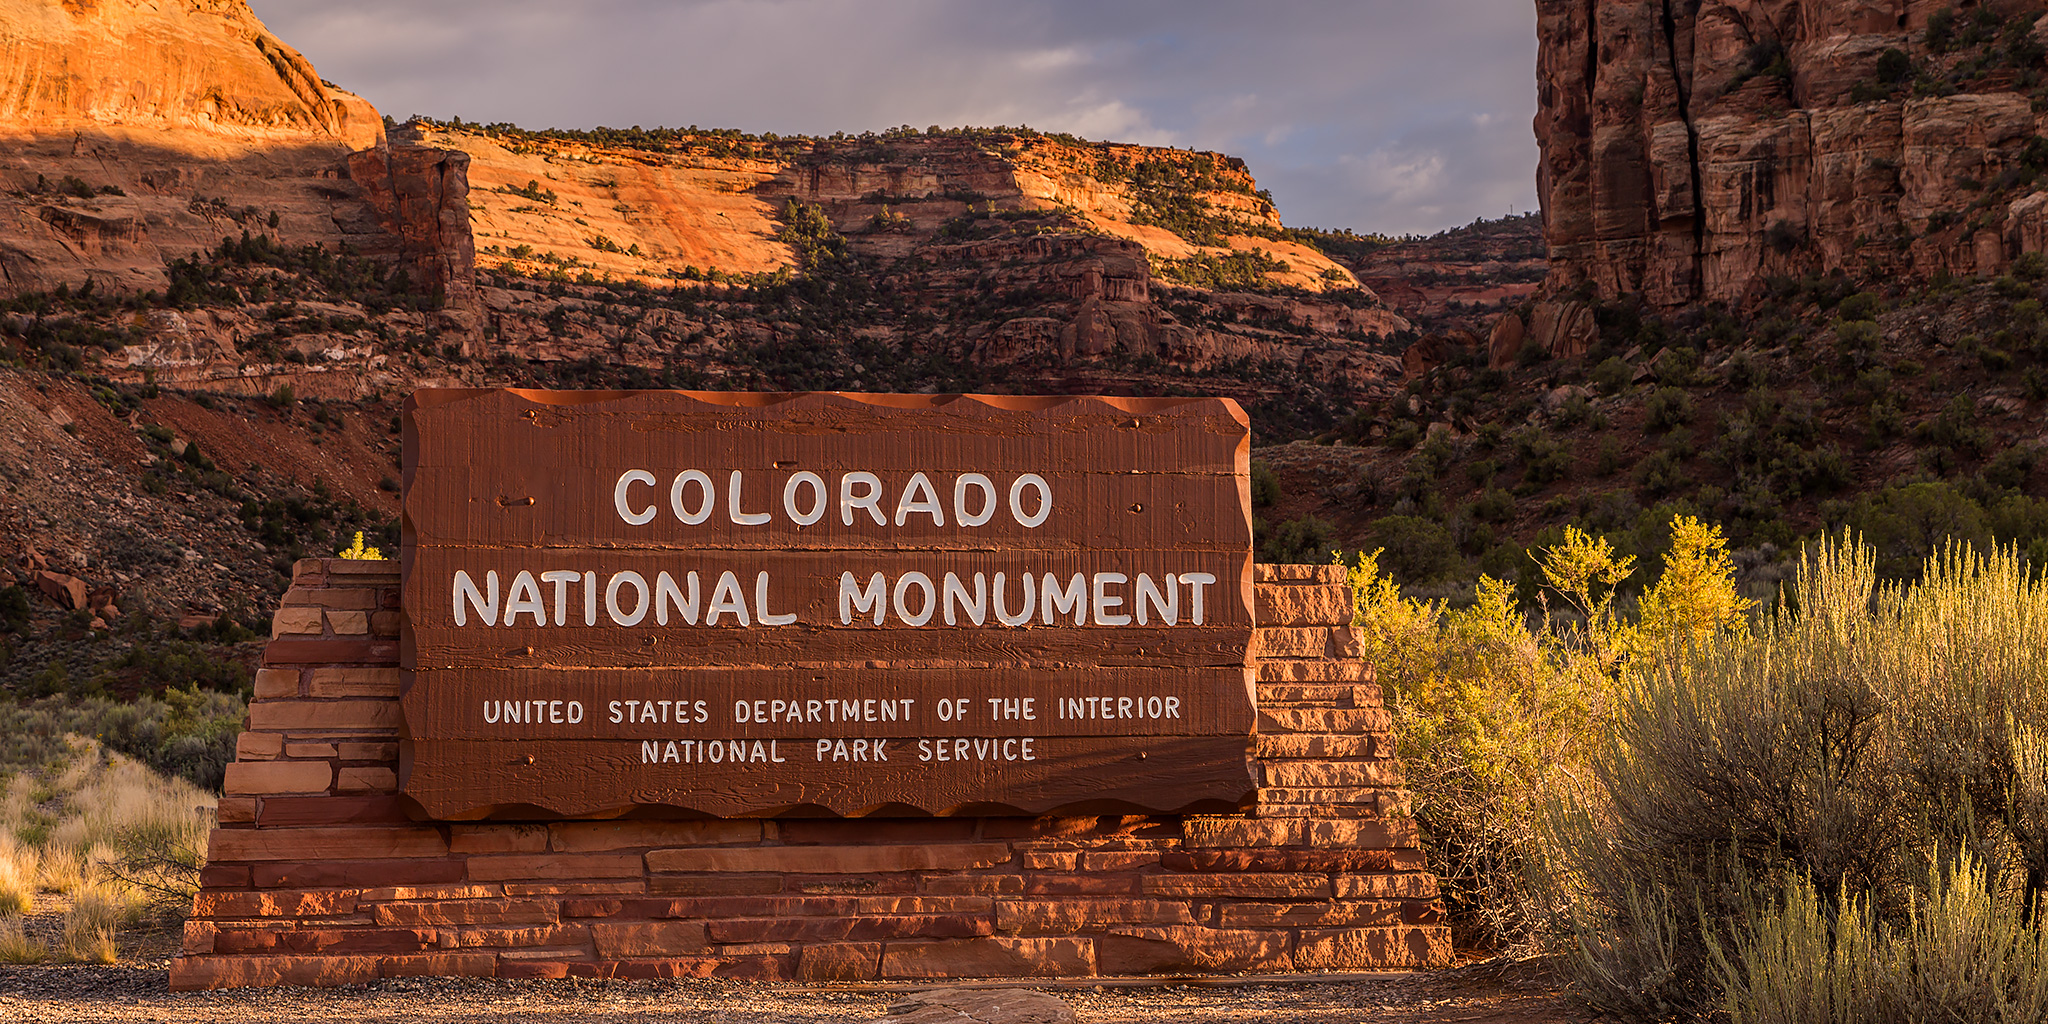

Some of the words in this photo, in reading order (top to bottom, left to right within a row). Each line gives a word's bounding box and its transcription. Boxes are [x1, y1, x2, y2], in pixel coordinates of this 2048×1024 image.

[614, 469, 1053, 529] COLORADO
[452, 569, 798, 627] NATIONAL
[837, 571, 1217, 627] MONUMENT
[483, 700, 584, 724] UNITED
[608, 700, 709, 724] STATES
[735, 699, 915, 724] DEPARTMENT
[937, 698, 971, 722] OF
[987, 697, 1037, 721] THE
[1059, 696, 1181, 720] INTERIOR
[641, 739, 786, 764] NATIONAL
[816, 738, 888, 763] PARK
[918, 737, 1036, 762] SERVICE
